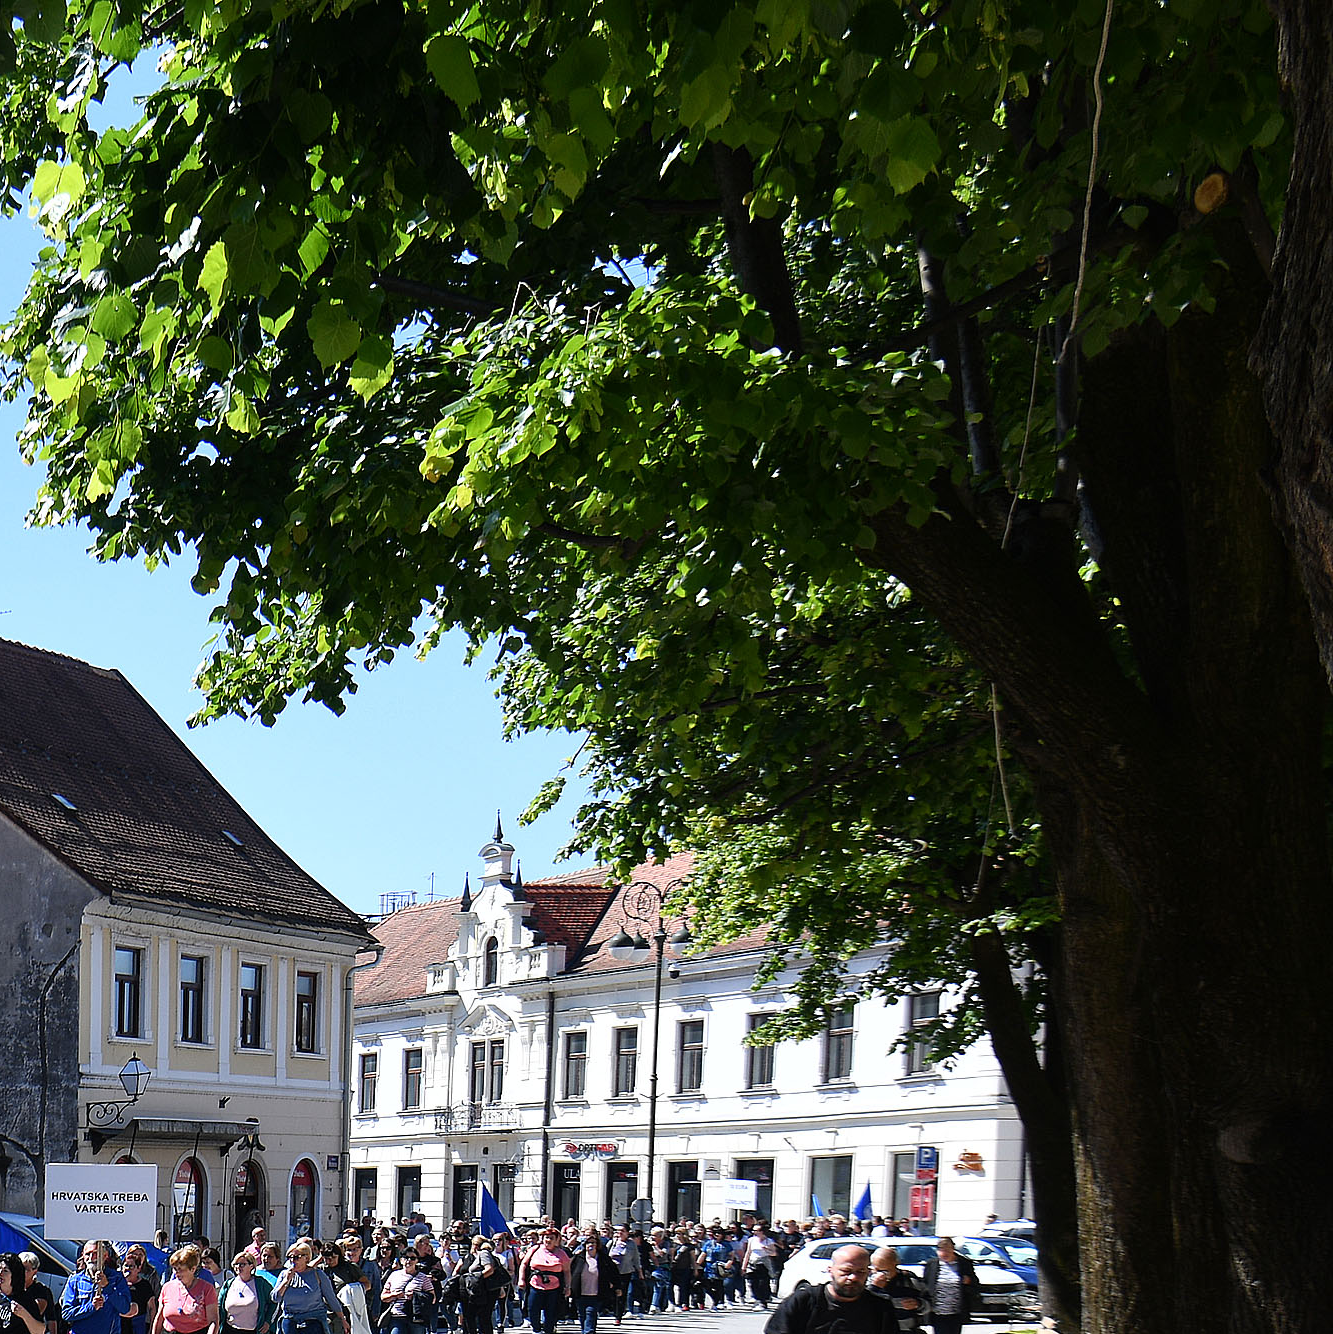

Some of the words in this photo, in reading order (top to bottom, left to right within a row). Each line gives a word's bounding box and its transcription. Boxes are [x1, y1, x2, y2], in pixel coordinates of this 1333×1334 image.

[51, 1191, 109, 1201] HRVATSKA
[112, 1193, 149, 1202] TREBA
[74, 1204, 125, 1214] VARTEKS
